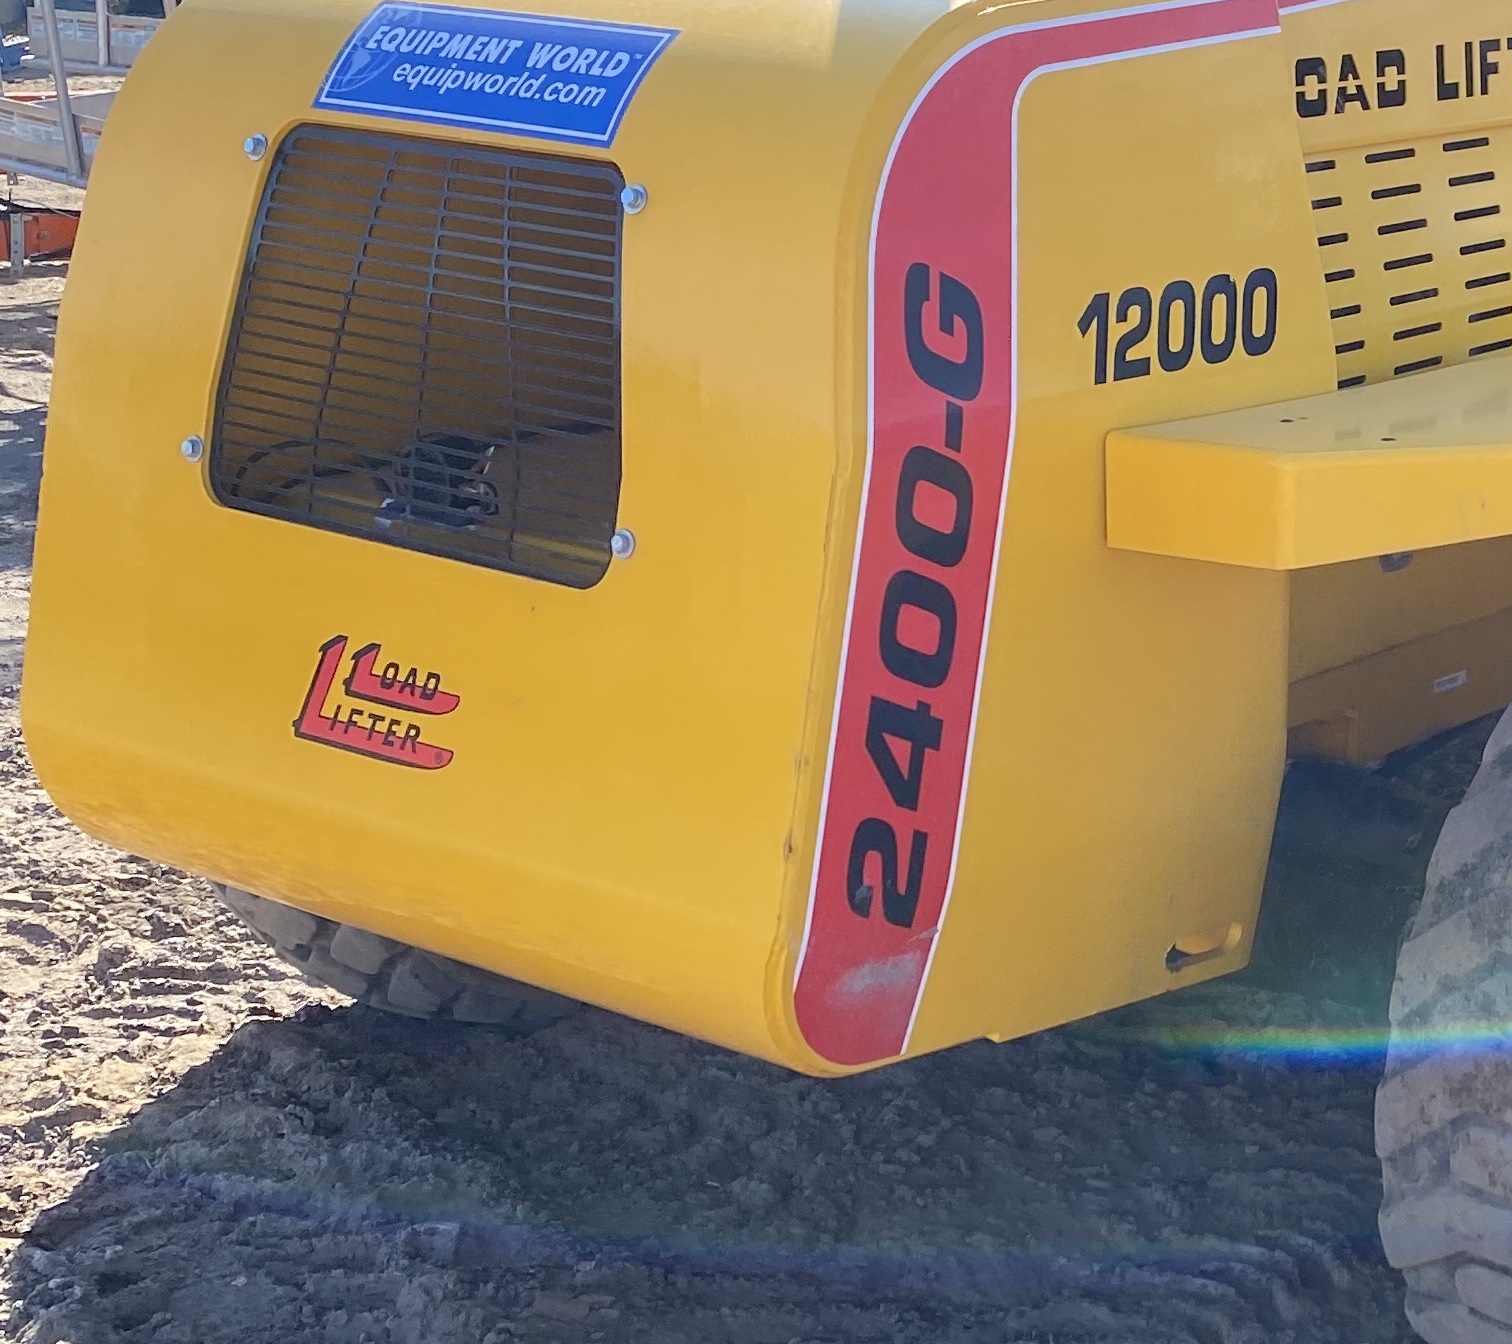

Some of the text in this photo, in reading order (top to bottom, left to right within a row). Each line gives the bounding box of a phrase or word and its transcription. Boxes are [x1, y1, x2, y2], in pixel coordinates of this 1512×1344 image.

[365, 24, 631, 79] EQUIPMENT WORLD
[392, 61, 607, 107] equipworld.com
[1077, 268, 1278, 386] 12000
[846, 261, 985, 929] 2400-G
